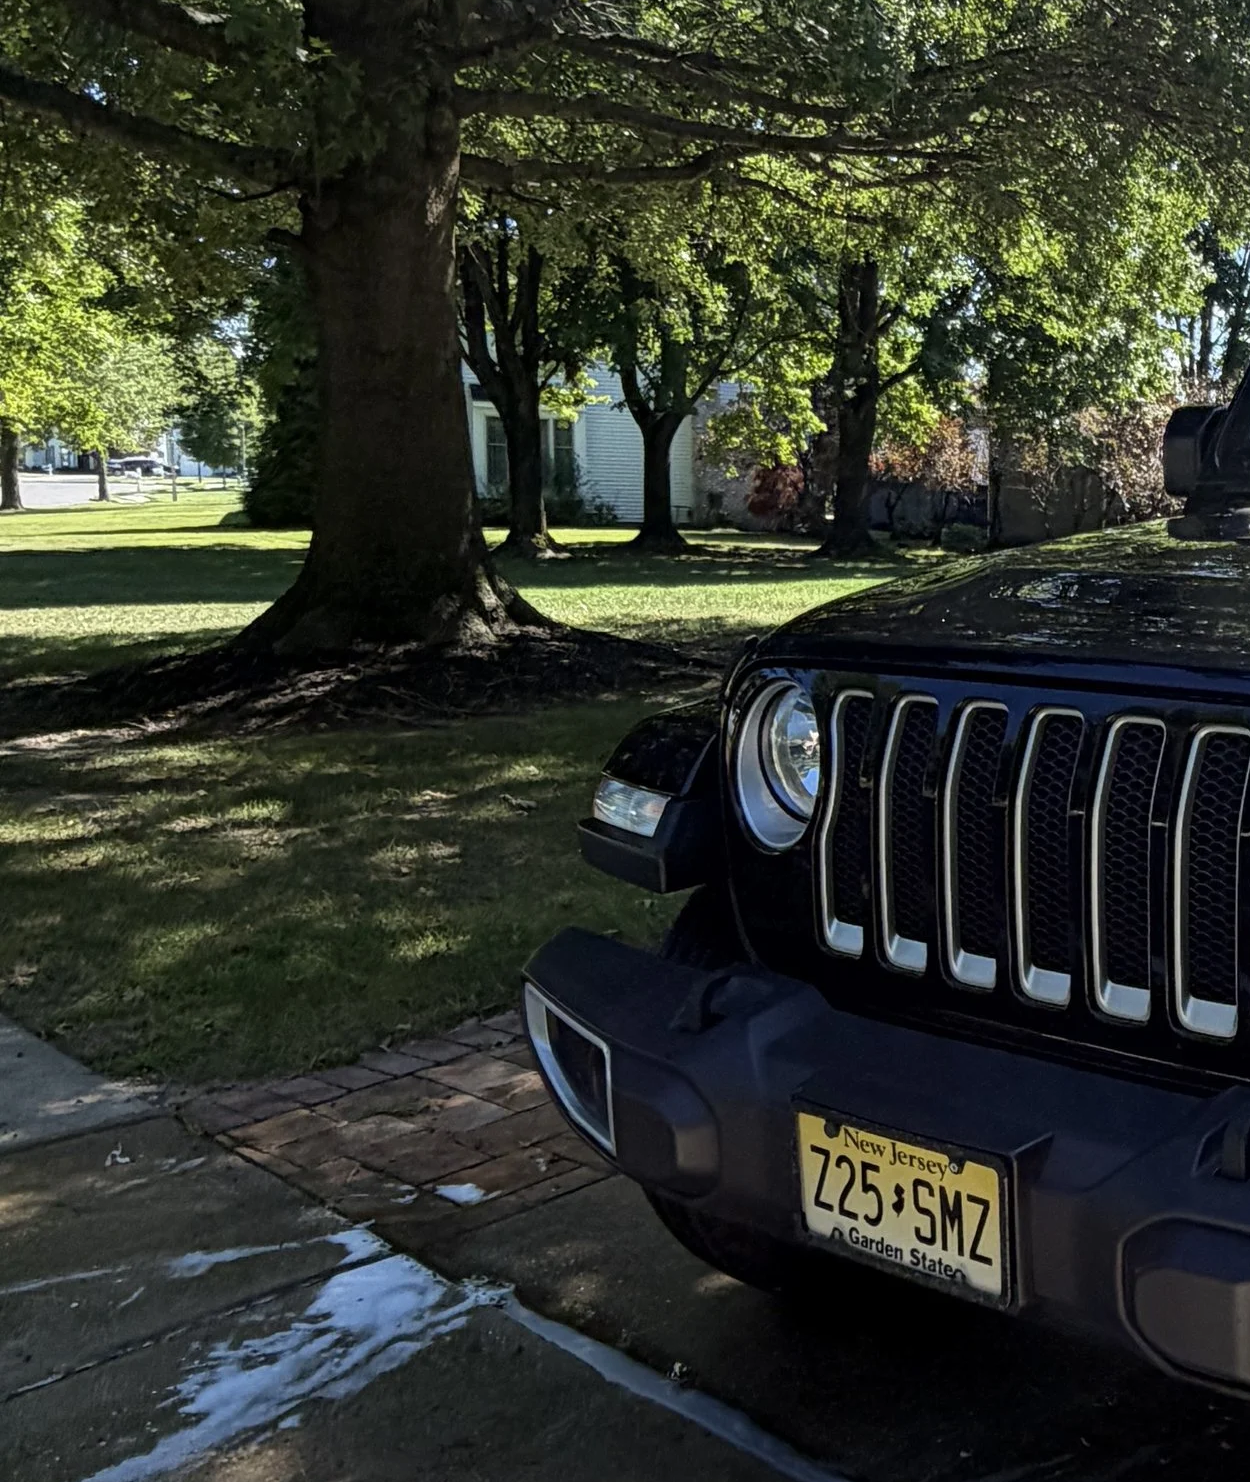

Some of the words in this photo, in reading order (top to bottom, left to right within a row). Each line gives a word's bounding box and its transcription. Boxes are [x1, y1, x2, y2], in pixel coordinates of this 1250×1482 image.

[843, 1128, 886, 1157] New
[889, 1142, 949, 1181] Jersey
[810, 1144, 884, 1226] Z25
[912, 1178, 993, 1267] SMZ
[849, 1227, 903, 1261] Garden
[910, 1249, 954, 1277] State
